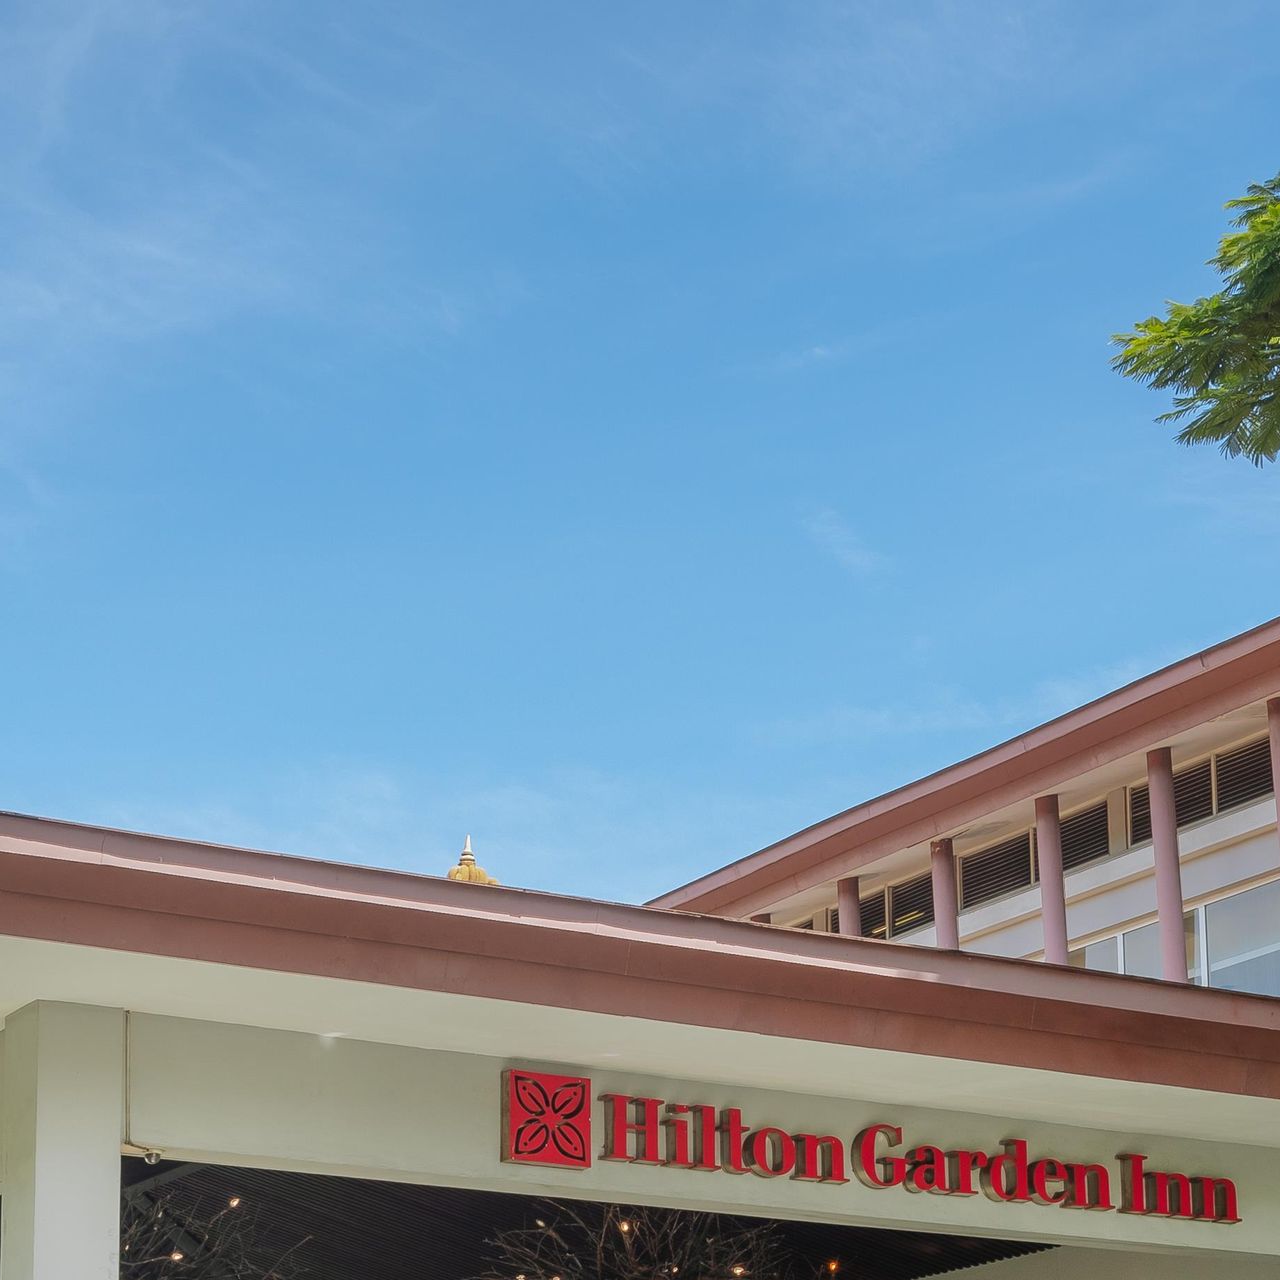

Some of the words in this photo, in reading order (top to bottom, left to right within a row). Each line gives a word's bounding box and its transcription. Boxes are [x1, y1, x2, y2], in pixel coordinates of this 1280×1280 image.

[597, 1093, 850, 1185] Hilton
[851, 1123, 1115, 1211] Garden
[1115, 1153, 1242, 1225] Inn
